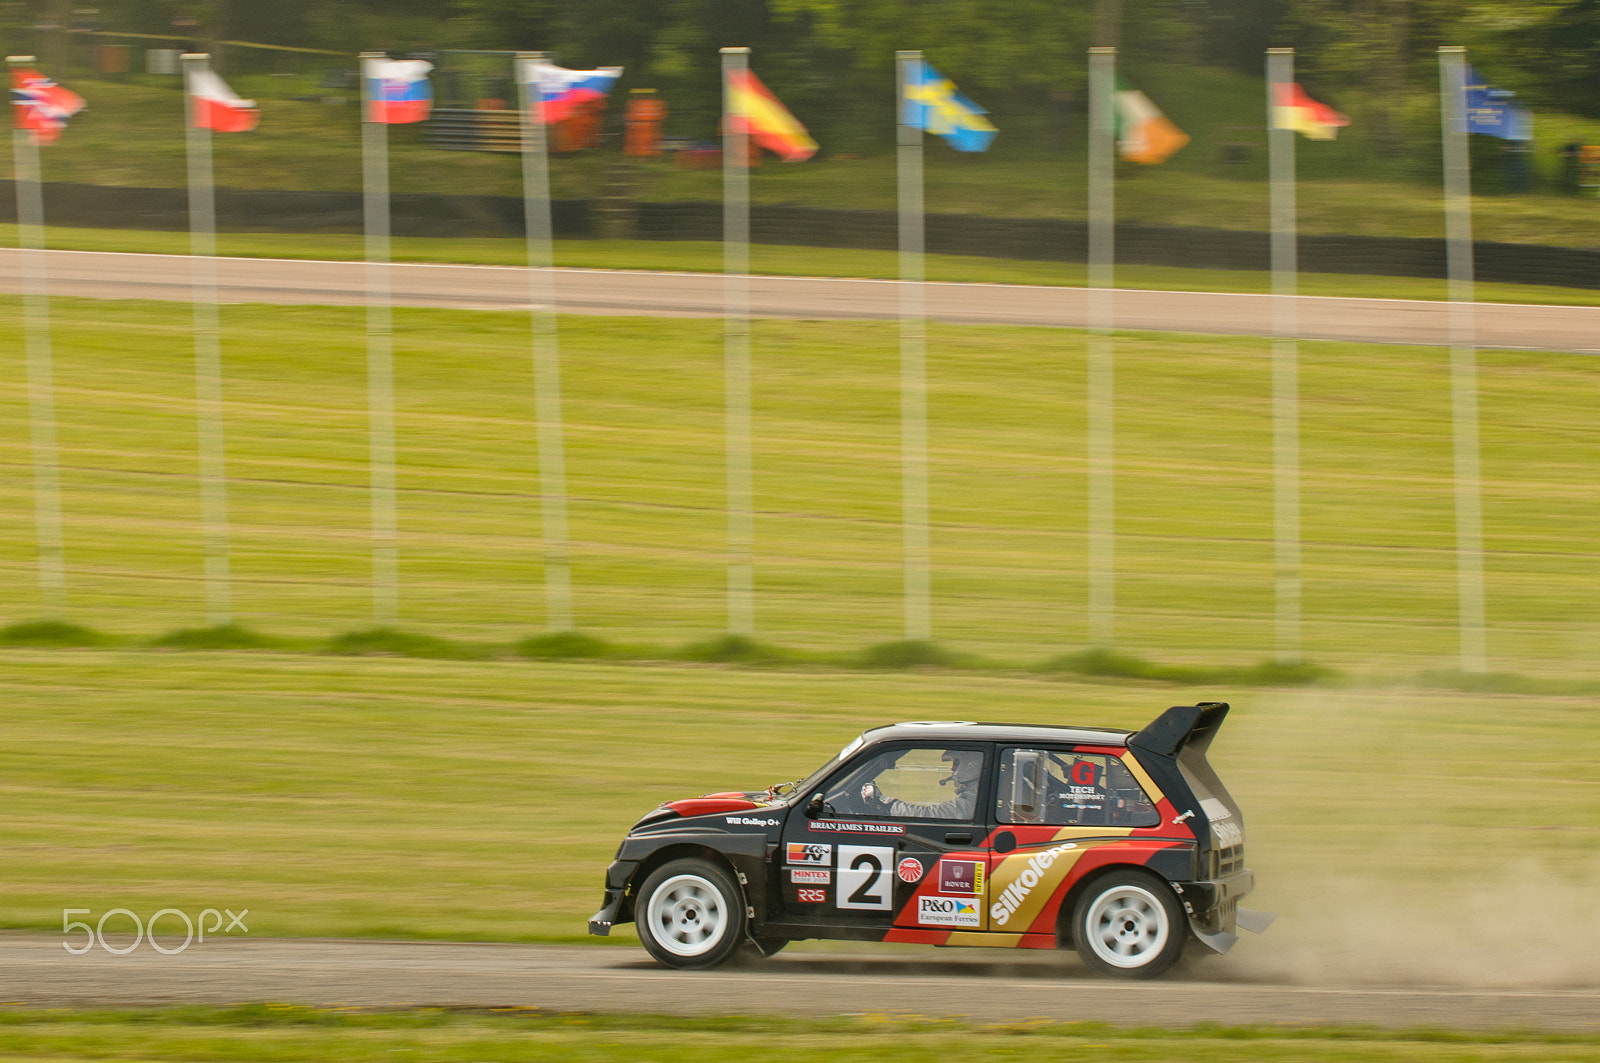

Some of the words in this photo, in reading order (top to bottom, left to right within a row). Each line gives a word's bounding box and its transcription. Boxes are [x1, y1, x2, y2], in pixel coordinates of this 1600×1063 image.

[1071, 761, 1095, 785] G
[1069, 786, 1095, 794] TECH
[726, 816, 741, 825] Will
[810, 821, 837, 829] BRIAN
[836, 823, 862, 831] JAMES
[863, 824, 904, 833] TRAILERS
[793, 870, 828, 878] MINTEX
[847, 853, 882, 905] 2
[944, 880, 971, 888] ROVER
[990, 842, 1077, 926] Silkolene
[798, 888, 825, 901] RRS
[921, 899, 954, 913] P&O
[920, 913, 953, 922] European
